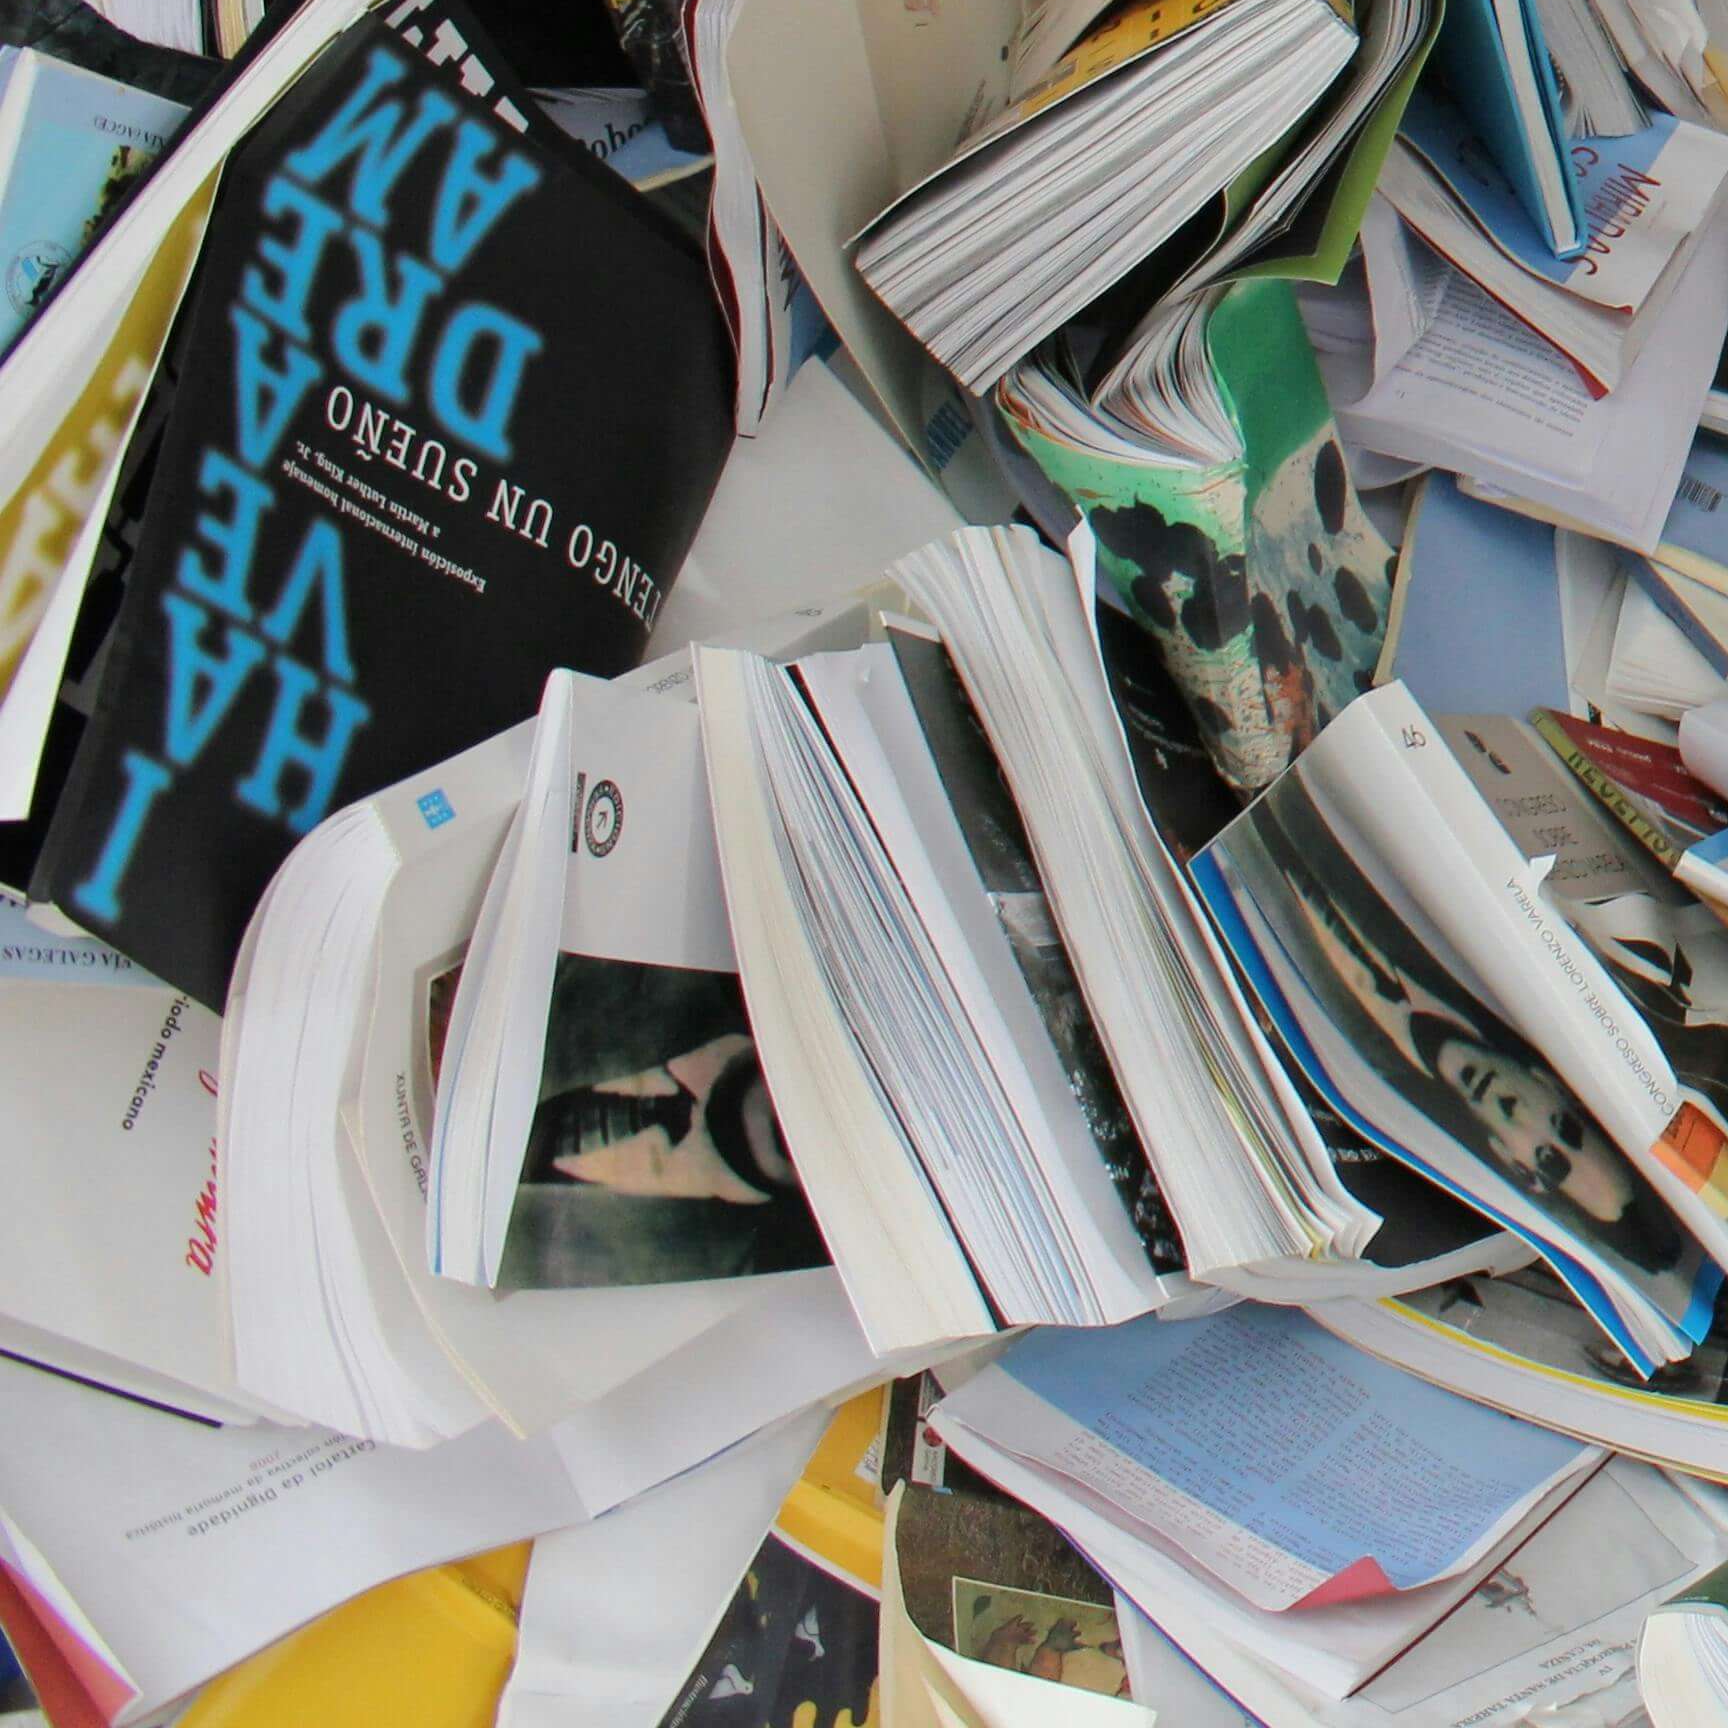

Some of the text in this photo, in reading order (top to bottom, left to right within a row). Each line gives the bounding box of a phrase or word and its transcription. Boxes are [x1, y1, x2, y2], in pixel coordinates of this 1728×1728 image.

[314, 452, 347, 483] King,
[325, 385, 662, 628] TENGO UN SUEÑO
[346, 475, 389, 511] Luther
[281, 459, 487, 595] Exposición internacional homenaje
[432, 526, 442, 539] a
[1401, 723, 1427, 750] 46
[1503, 875, 1676, 1118] CONGRESO SOBRE LORENZO VARELA
[121, 994, 192, 1133] iodo mexicano
[402, 1128, 417, 1154] DE
[245, 1469, 263, 1484] da
[279, 1470, 306, 1491] da
[184, 1476, 246, 1516] memoria
[186, 1484, 281, 1539] Dignidade
[124, 1500, 186, 1541] histórica
